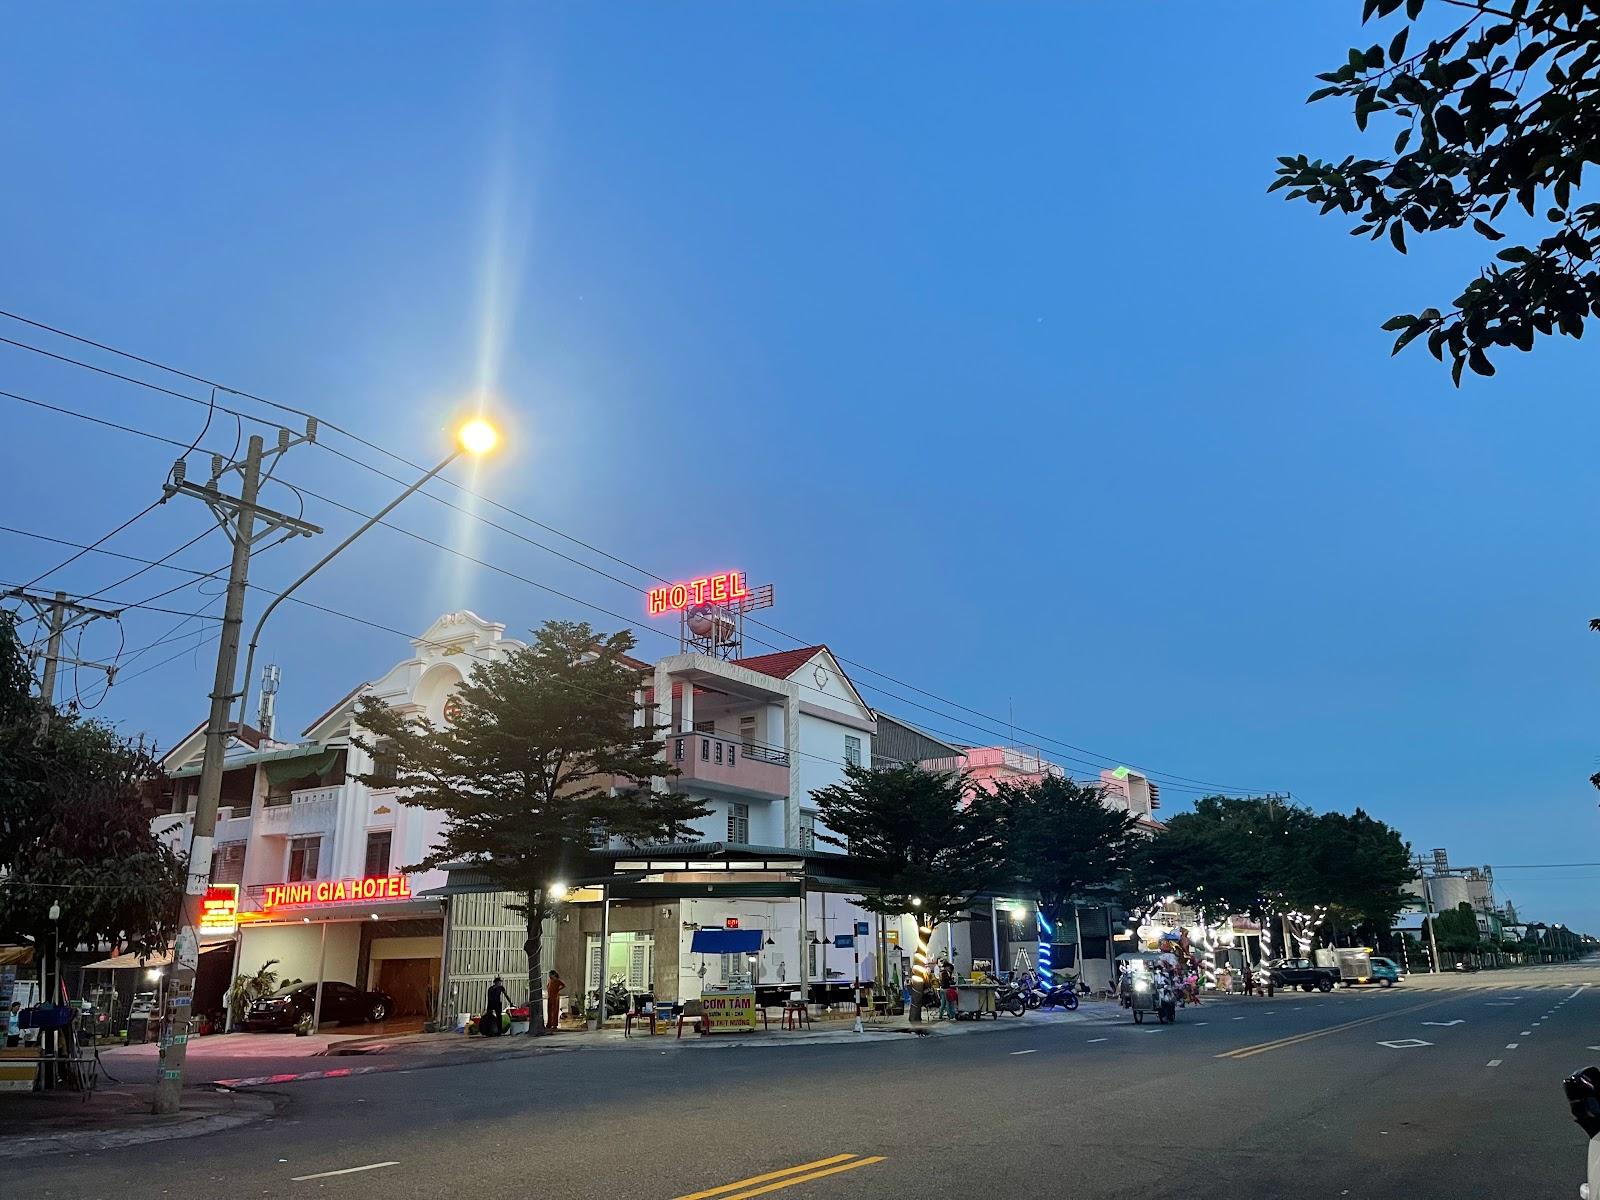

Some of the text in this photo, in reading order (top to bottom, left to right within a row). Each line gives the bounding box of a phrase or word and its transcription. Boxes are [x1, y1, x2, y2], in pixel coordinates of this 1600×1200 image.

[649, 572, 745, 614] HOTEL
[316, 882, 346, 901] GIA
[351, 876, 411, 898] HOTEL
